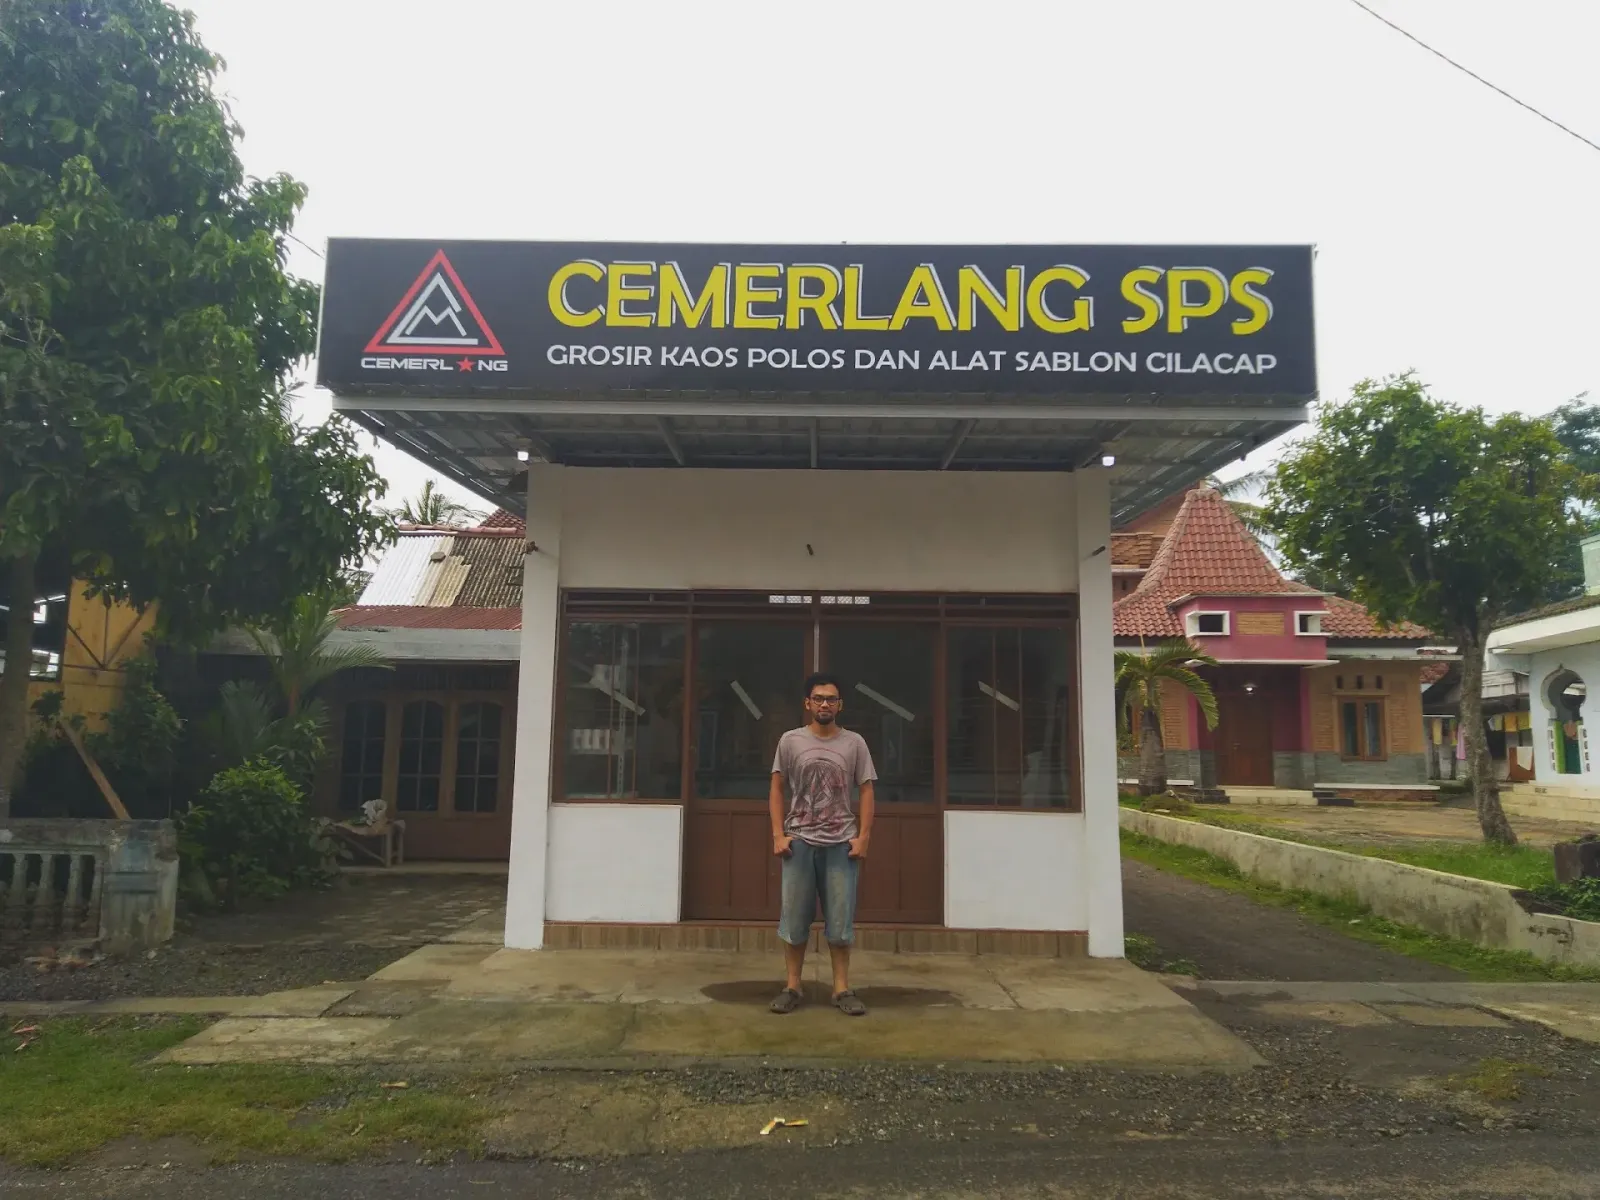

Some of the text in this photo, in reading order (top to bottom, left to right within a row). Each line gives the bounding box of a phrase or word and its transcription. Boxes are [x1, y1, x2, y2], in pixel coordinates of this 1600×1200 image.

[548, 258, 1274, 336] CEMERLANG SPS
[546, 344, 1278, 375] GROSIR KAOS POLOS DAN ALAT SABLON CILACAP
